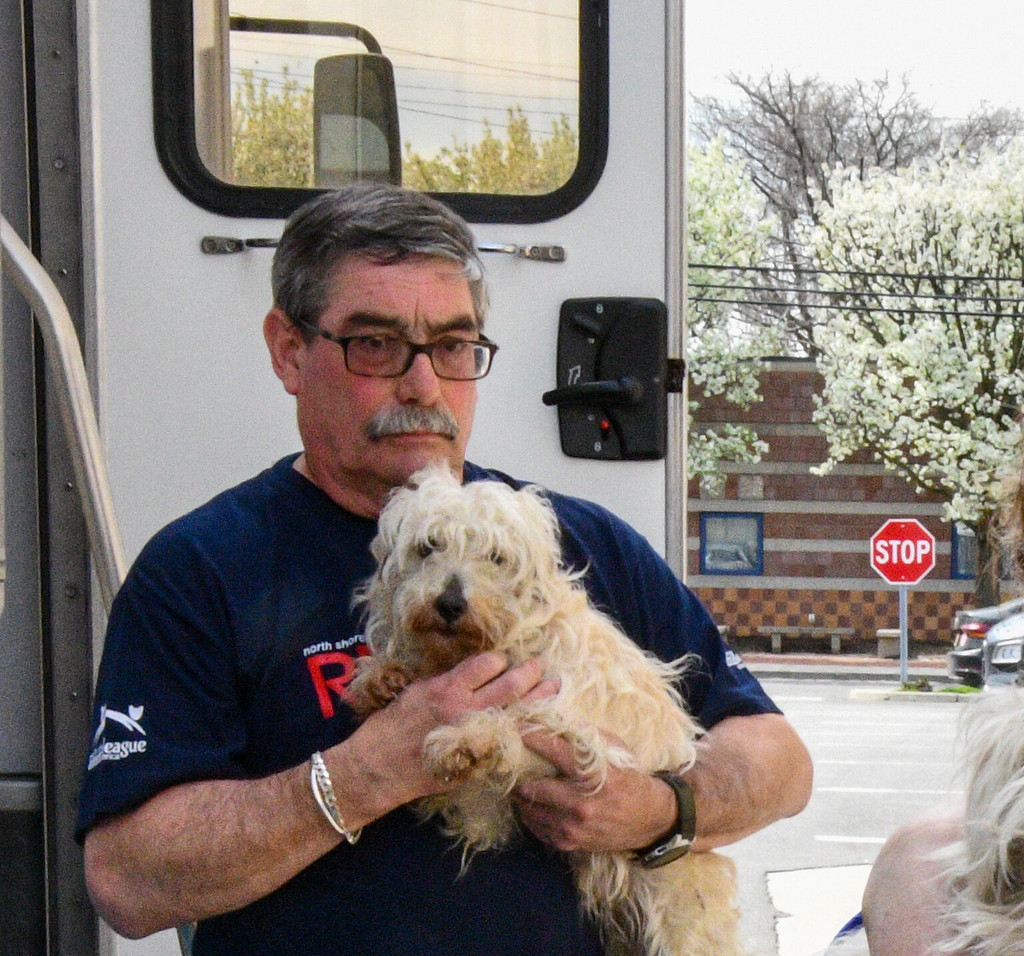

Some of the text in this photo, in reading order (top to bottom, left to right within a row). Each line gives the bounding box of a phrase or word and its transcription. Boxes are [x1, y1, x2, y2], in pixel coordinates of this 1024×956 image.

[875, 539, 931, 565] STOP
[303, 634, 366, 657] north shore
